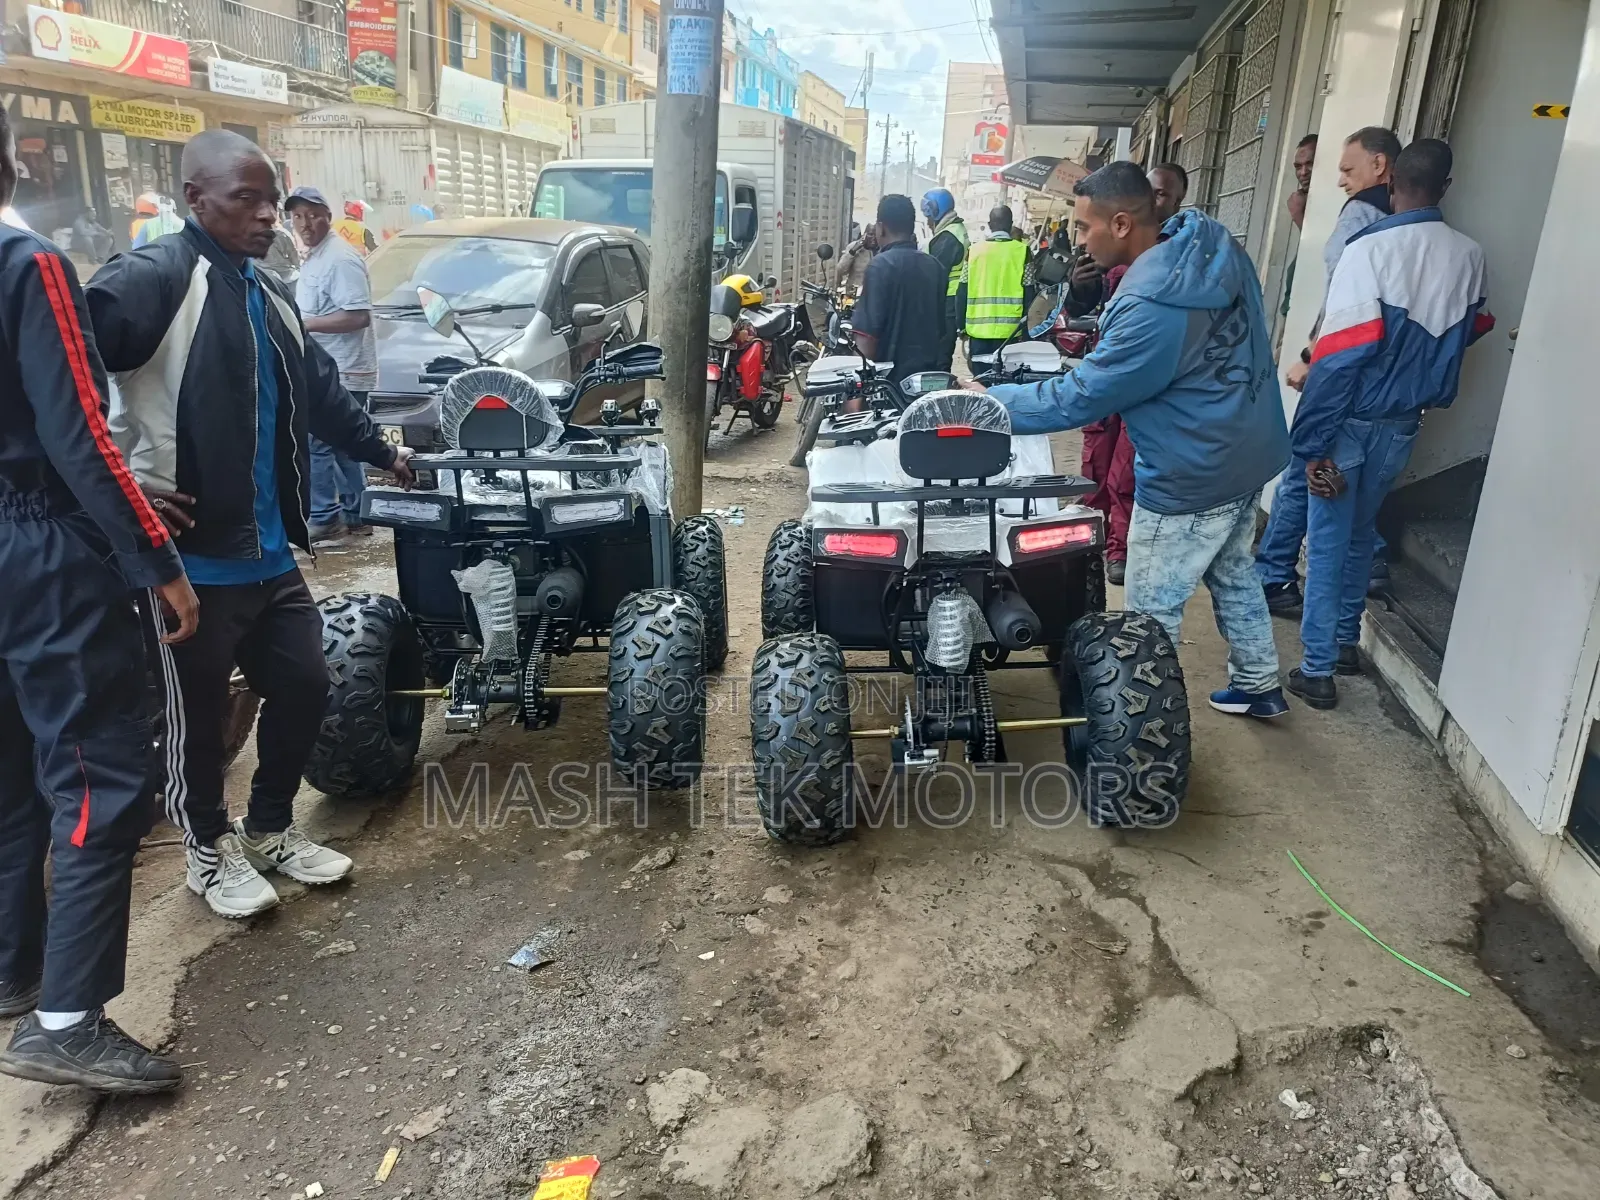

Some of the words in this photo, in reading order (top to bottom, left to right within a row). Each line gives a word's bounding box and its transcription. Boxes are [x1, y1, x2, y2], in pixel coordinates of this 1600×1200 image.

[349, 21, 397, 32] EMBROIDERY
[71, 34, 101, 50] HELIX
[96, 100, 125, 113] LYMA
[127, 104, 161, 119] MOTOR
[163, 110, 196, 124] SPARES
[311, 114, 349, 122] HYUNDAI
[104, 112, 112, 122] &
[115, 114, 174, 131] LUBRICANTS
[176, 123, 192, 133] LTD
[1018, 163, 1048, 177] TEMBO
[1024, 159, 1052, 171] SENKE
